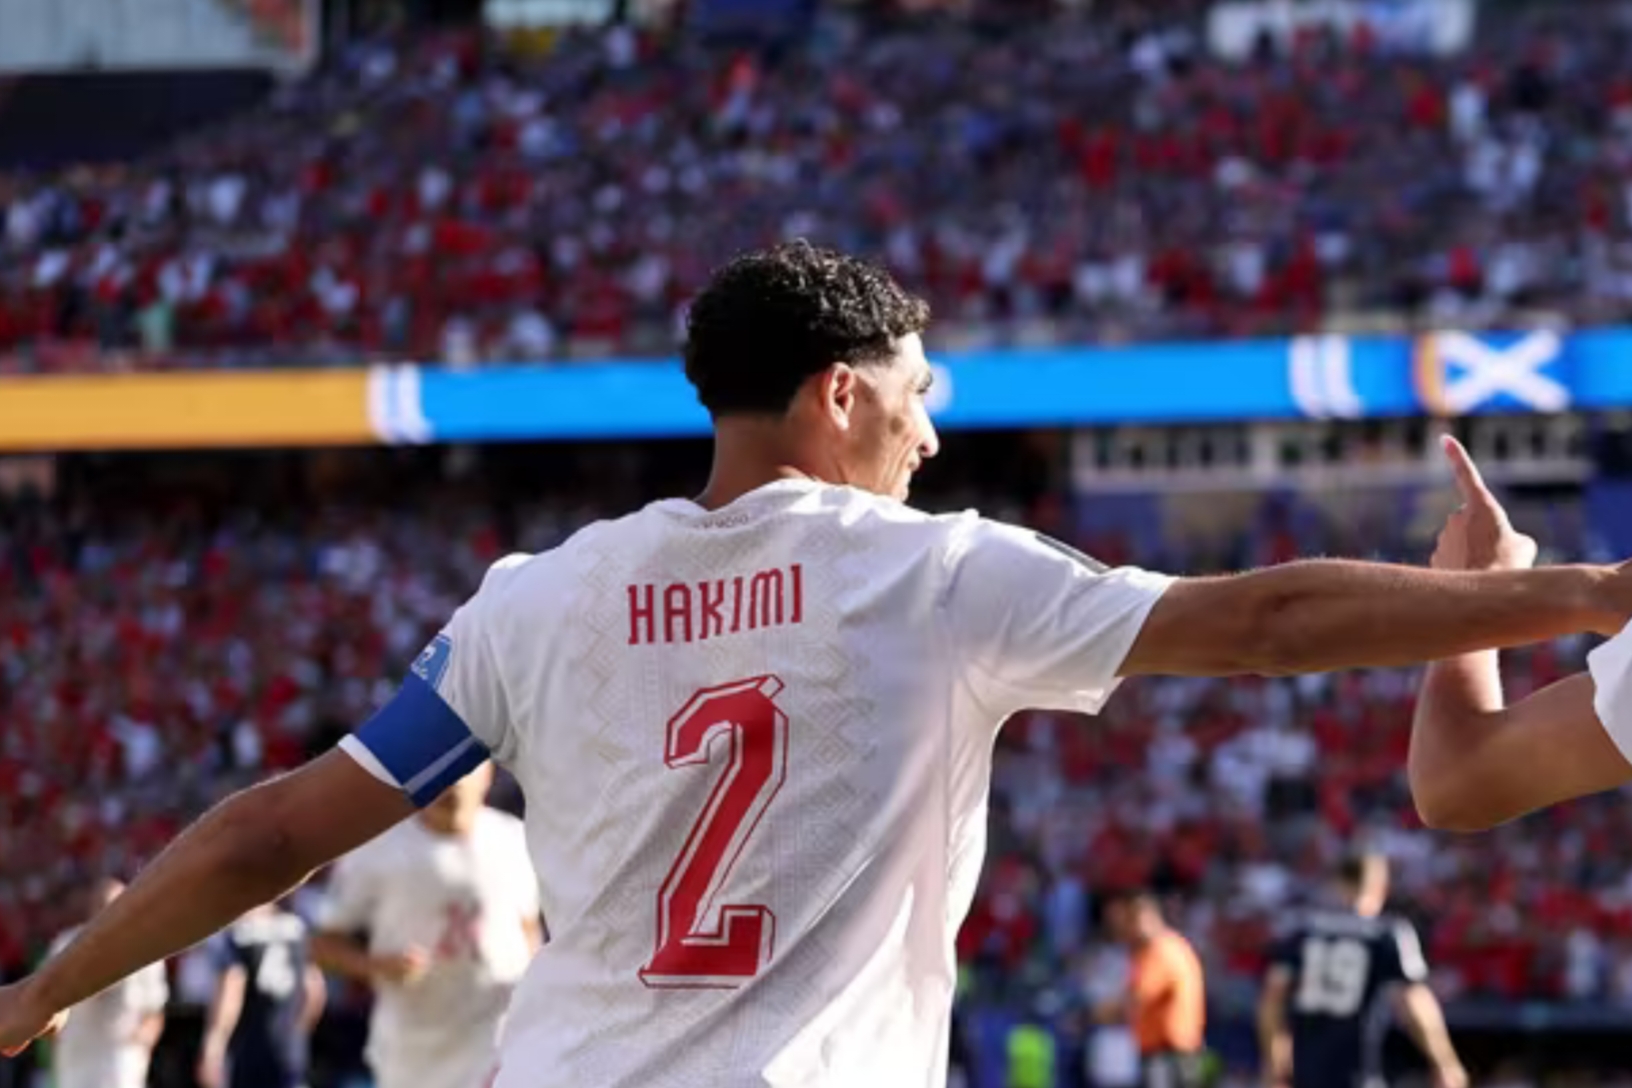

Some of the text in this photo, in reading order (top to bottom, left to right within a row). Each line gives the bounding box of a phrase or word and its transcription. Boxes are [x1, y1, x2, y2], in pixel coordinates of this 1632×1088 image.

[627, 563, 802, 645] HAKIMI
[637, 674, 789, 989] 2
[1300, 938, 1369, 1015] 19
